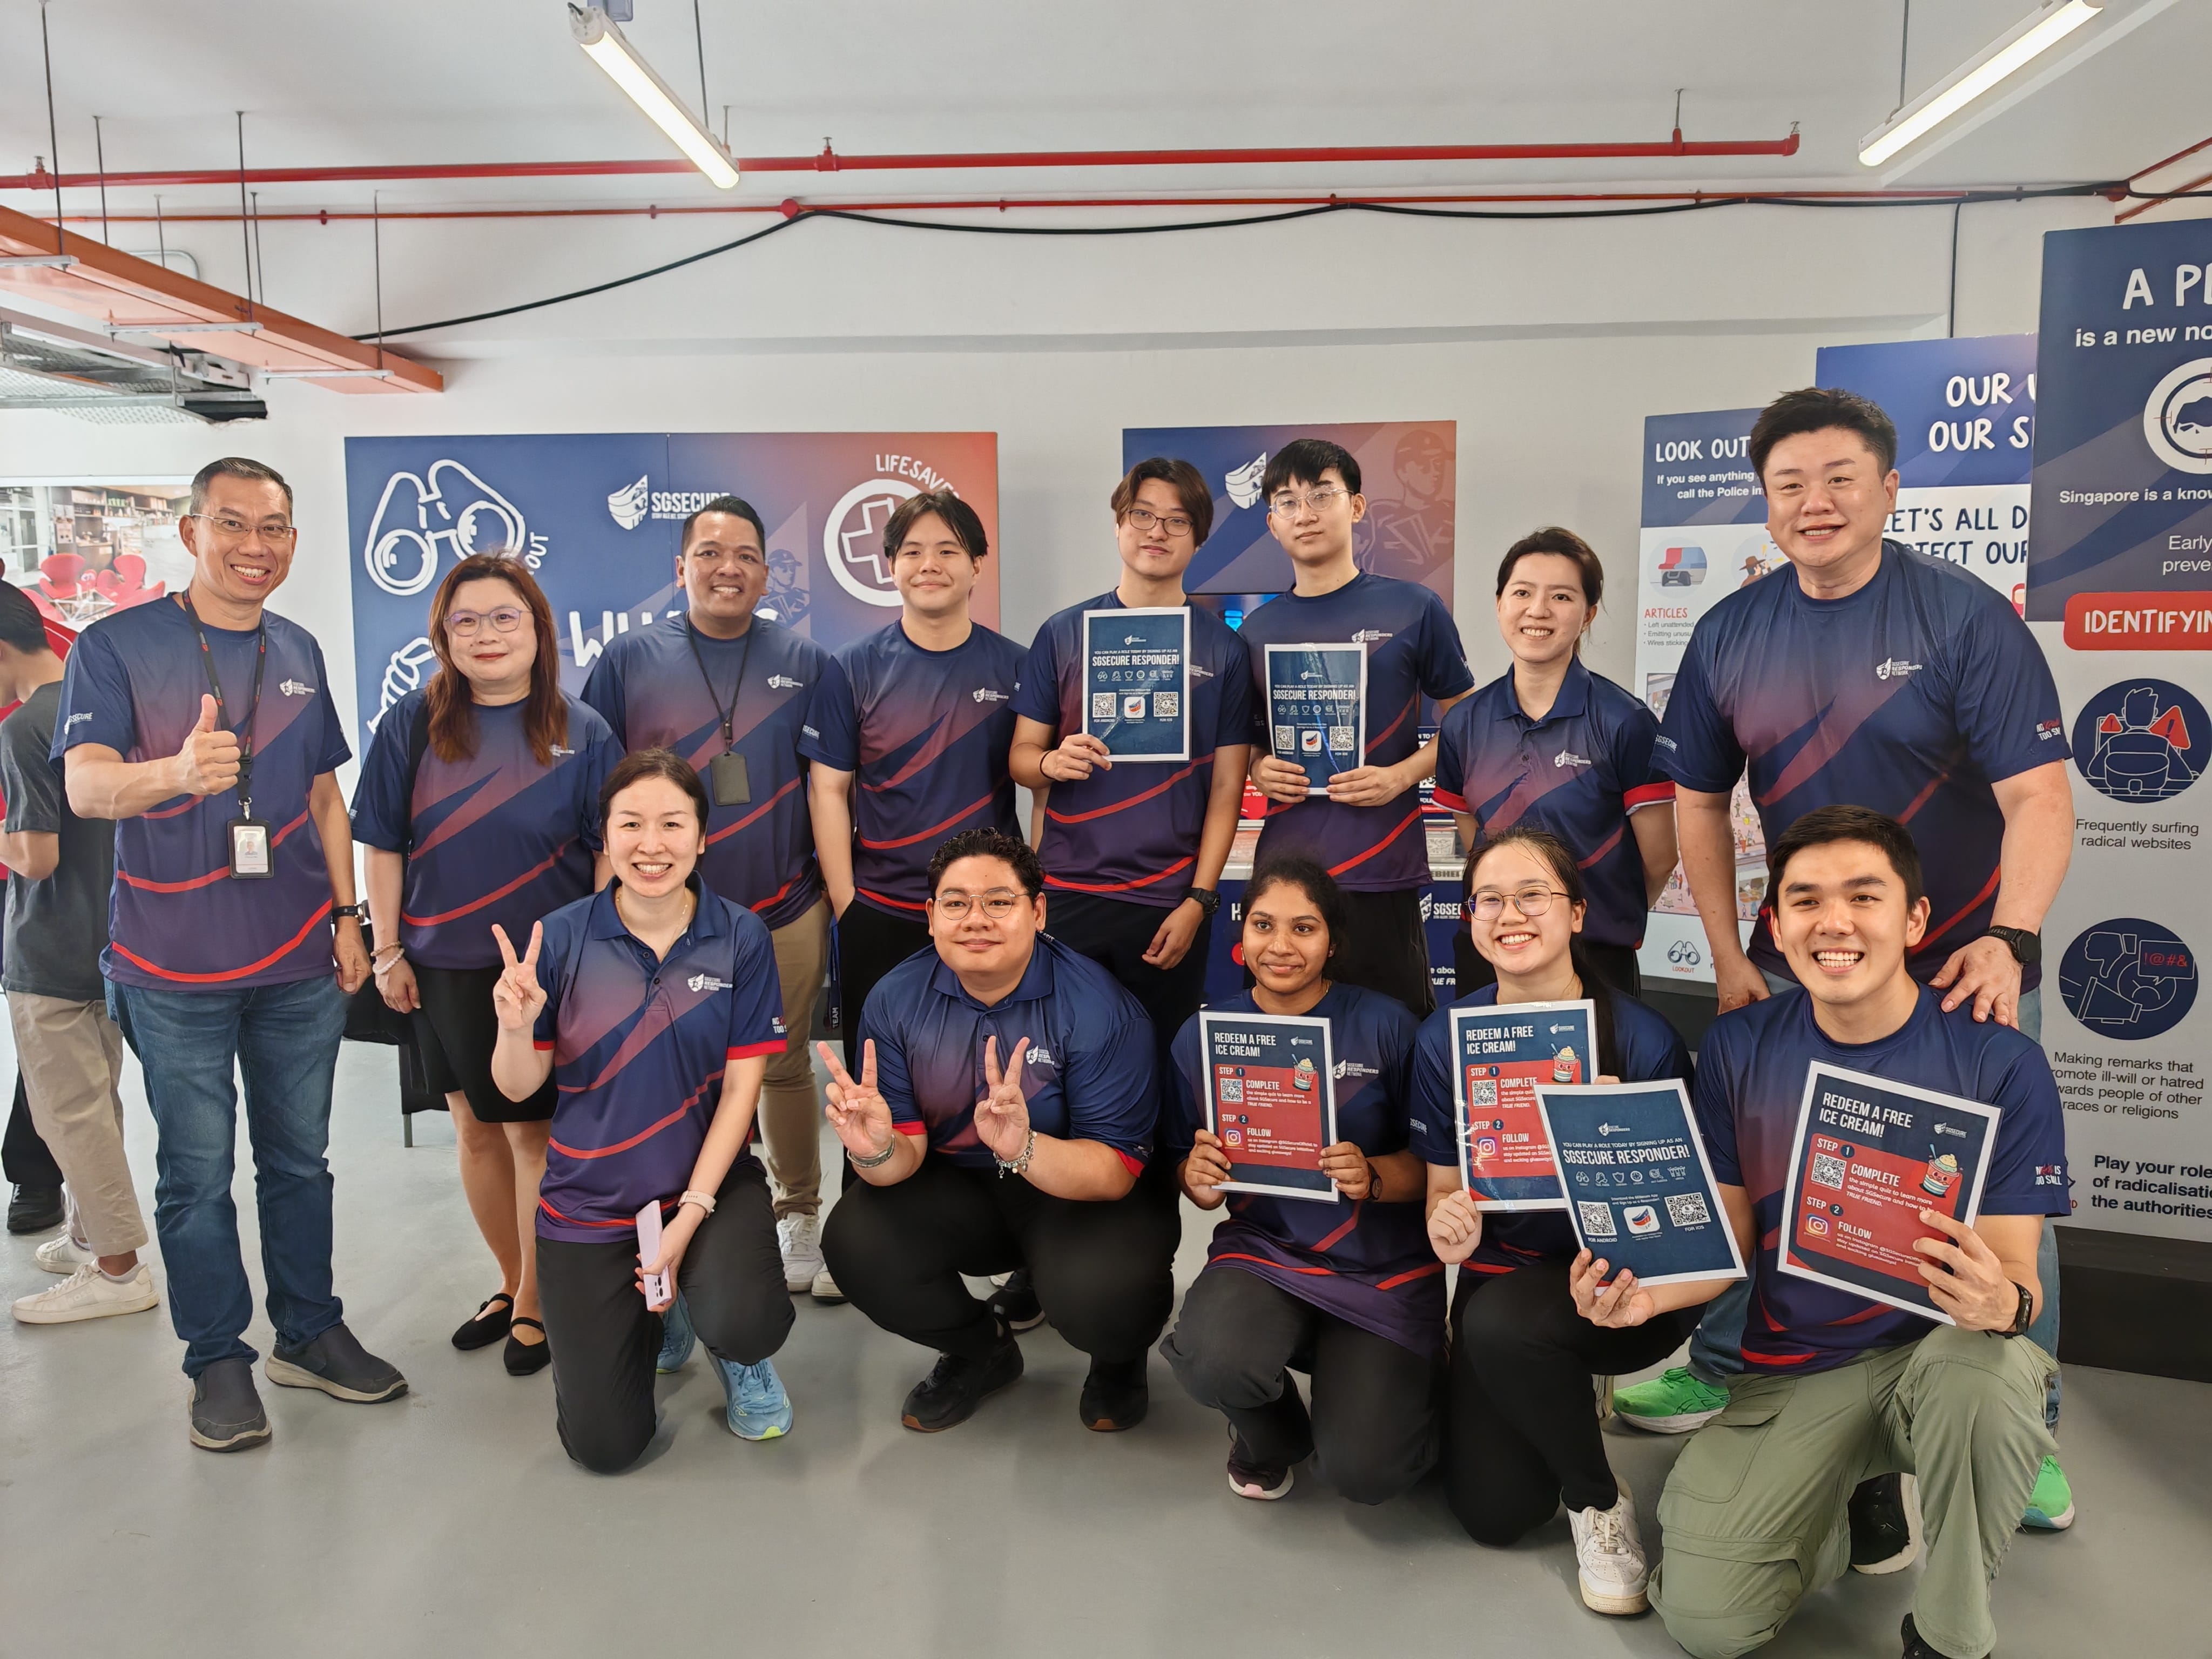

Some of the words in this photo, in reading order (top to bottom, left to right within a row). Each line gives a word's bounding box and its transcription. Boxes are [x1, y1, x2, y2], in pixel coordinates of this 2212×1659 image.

[2122, 268, 2154, 310] A
[2075, 328, 2096, 347] is
[2103, 331, 2117, 346] a
[2126, 327, 2177, 345] new
[1946, 372, 2014, 408] OUR
[1929, 417, 1995, 453] OUR
[2008, 415, 2035, 449] S
[1655, 439, 1704, 463] LOOK
[1710, 436, 1752, 460] OUT
[875, 454, 960, 499] LIFESAV
[1656, 475, 1664, 484] If
[1667, 475, 1685, 486] you
[1688, 474, 1707, 483] see
[1709, 470, 1755, 483] anything
[651, 491, 730, 513] SGSECU
[1677, 489, 1695, 499] call
[1697, 488, 1715, 498] the
[1717, 487, 1749, 497] Police
[2059, 490, 2140, 505] Singapore
[2144, 488, 2158, 501] is
[2162, 490, 2172, 501] a
[1955, 507, 1999, 531] ALL
[2168, 535, 2212, 554] Early
[2162, 559, 2212, 576] preve
[1644, 607, 1688, 619] ARTICLES
[1092, 655, 1130, 666] SGSECURE
[1131, 654, 1180, 665] RESPONDER!
[1273, 689, 1307, 700] SGSECURE
[1308, 689, 1356, 700] RESPONDER!
[2076, 819, 2147, 834] Frequently
[2152, 822, 2199, 837] surfing
[2081, 836, 2126, 847] radical
[2131, 838, 2191, 850] websites
[1215, 1032, 1247, 1044] REDEEM
[1249, 1034, 1255, 1045] A
[1256, 1035, 1277, 1046] FREE
[1466, 1028, 1501, 1041] REDEEM
[1503, 1028, 1510, 1038] A
[1512, 1026, 1534, 1038] FREE
[1215, 1044, 1228, 1055] ICE
[1230, 1046, 1260, 1057] CREAM!
[1466, 1043, 1481, 1055] ICE
[1482, 1041, 1516, 1053] CREAM!
[1219, 1067, 1234, 1075] STEP
[2054, 1051, 2102, 1068] Making
[2108, 1057, 2163, 1071] remarks
[2167, 1060, 2194, 1073] that
[1471, 1068, 1487, 1077] STEP
[2102, 1070, 2136, 1084] ill-will
[2141, 1076, 2156, 1086] or
[2160, 1075, 2204, 1090] hatred
[1246, 1080, 1280, 1090] COMPLETE
[2098, 1088, 2144, 1102] people
[2149, 1091, 2163, 1102] of
[2167, 1093, 2202, 1105] other
[1222, 1114, 1237, 1123] STEP
[1822, 1092, 1870, 1119] REDEEM
[1871, 1105, 1880, 1120] A
[1882, 1108, 1914, 1129] FREE
[2062, 1101, 2099, 1112] races
[2103, 1104, 2119, 1114] or
[2122, 1105, 2179, 1120] religions
[1474, 1121, 1490, 1130] STEP
[1496, 1121, 1501, 1129] 2
[1818, 1108, 1838, 1125] ICE
[1839, 1114, 1886, 1138] CREAM!
[1247, 1128, 1271, 1137] FOLLOW
[1502, 1133, 1529, 1143] FOLLOW
[1562, 1149, 1616, 1165] SGSECURE
[1616, 1144, 1690, 1164] RESPONDER!
[1817, 1137, 1838, 1152] STEP
[1845, 1145, 1851, 1156] 1
[1851, 1163, 1901, 1188] COMPLETE
[2094, 1155, 2130, 1174] Play
[2135, 1160, 2175, 1175] your
[2180, 1164, 2212, 1178] role
[2093, 1175, 2110, 1188] of
[1846, 1190, 1861, 1200] TRUE
[1861, 1196, 1883, 1207] FRIEND.
[1847, 1184, 1864, 1193] about
[1865, 1189, 1892, 1202] SGSecure
[1892, 1198, 1904, 1206] and
[1905, 1201, 1918, 1209] how
[1859, 1181, 1879, 1190] simple
[1879, 1185, 1891, 1193] quiz
[1900, 1191, 1916, 1201] learn
[1917, 1197, 1933, 1205] more
[1806, 1196, 1827, 1210] STEP
[1834, 1204, 1840, 1215] 2
[2091, 1194, 2119, 1210] the
[2123, 1199, 2212, 1219] authorities
[1838, 1220, 1872, 1240] FOLLOW
